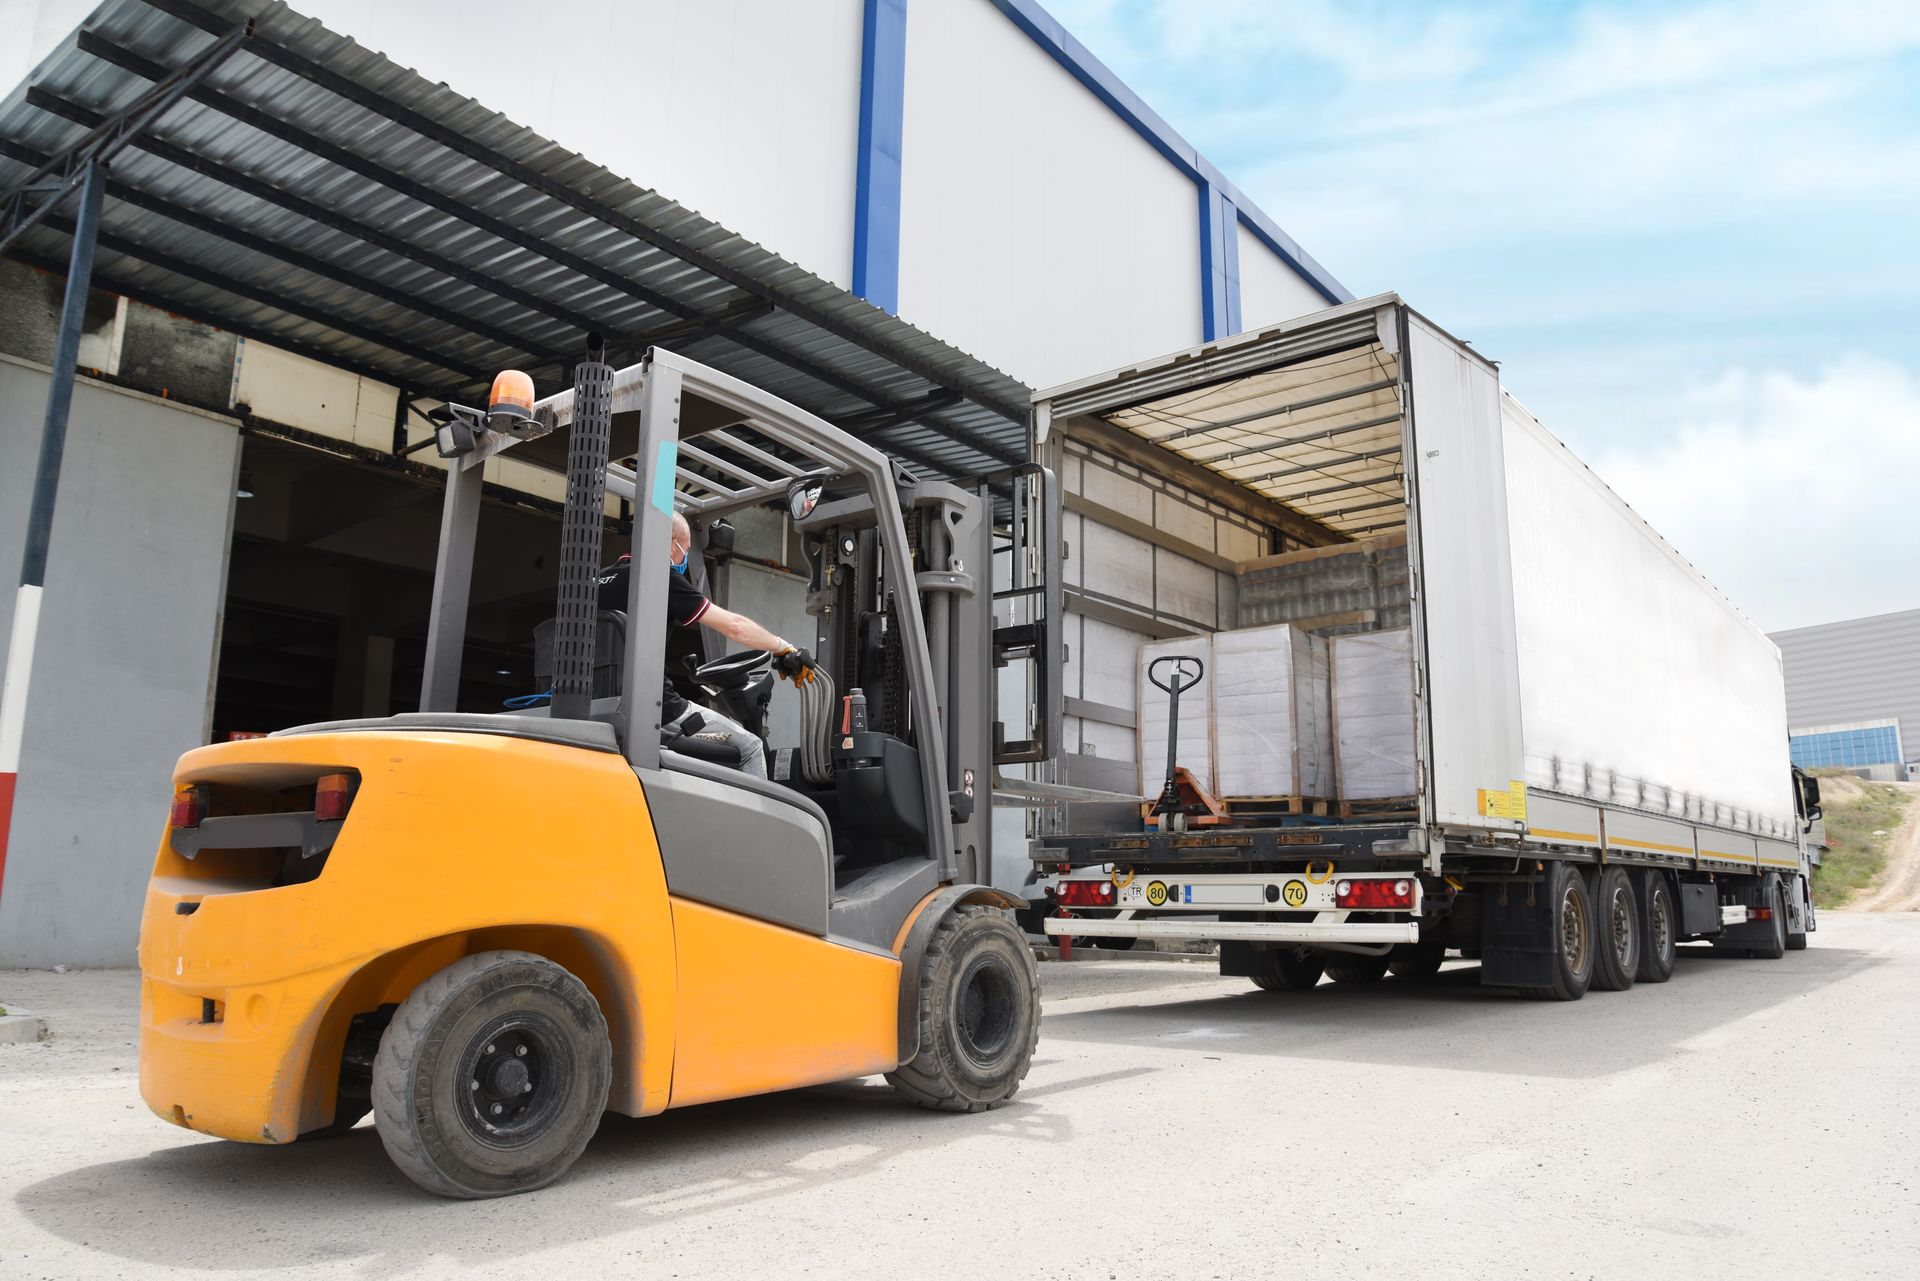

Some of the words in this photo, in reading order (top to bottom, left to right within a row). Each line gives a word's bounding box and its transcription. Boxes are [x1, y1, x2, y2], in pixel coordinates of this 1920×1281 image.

[1131, 887, 1142, 896] TR
[1150, 887, 1164, 899] 80
[1287, 888, 1303, 900] 70
